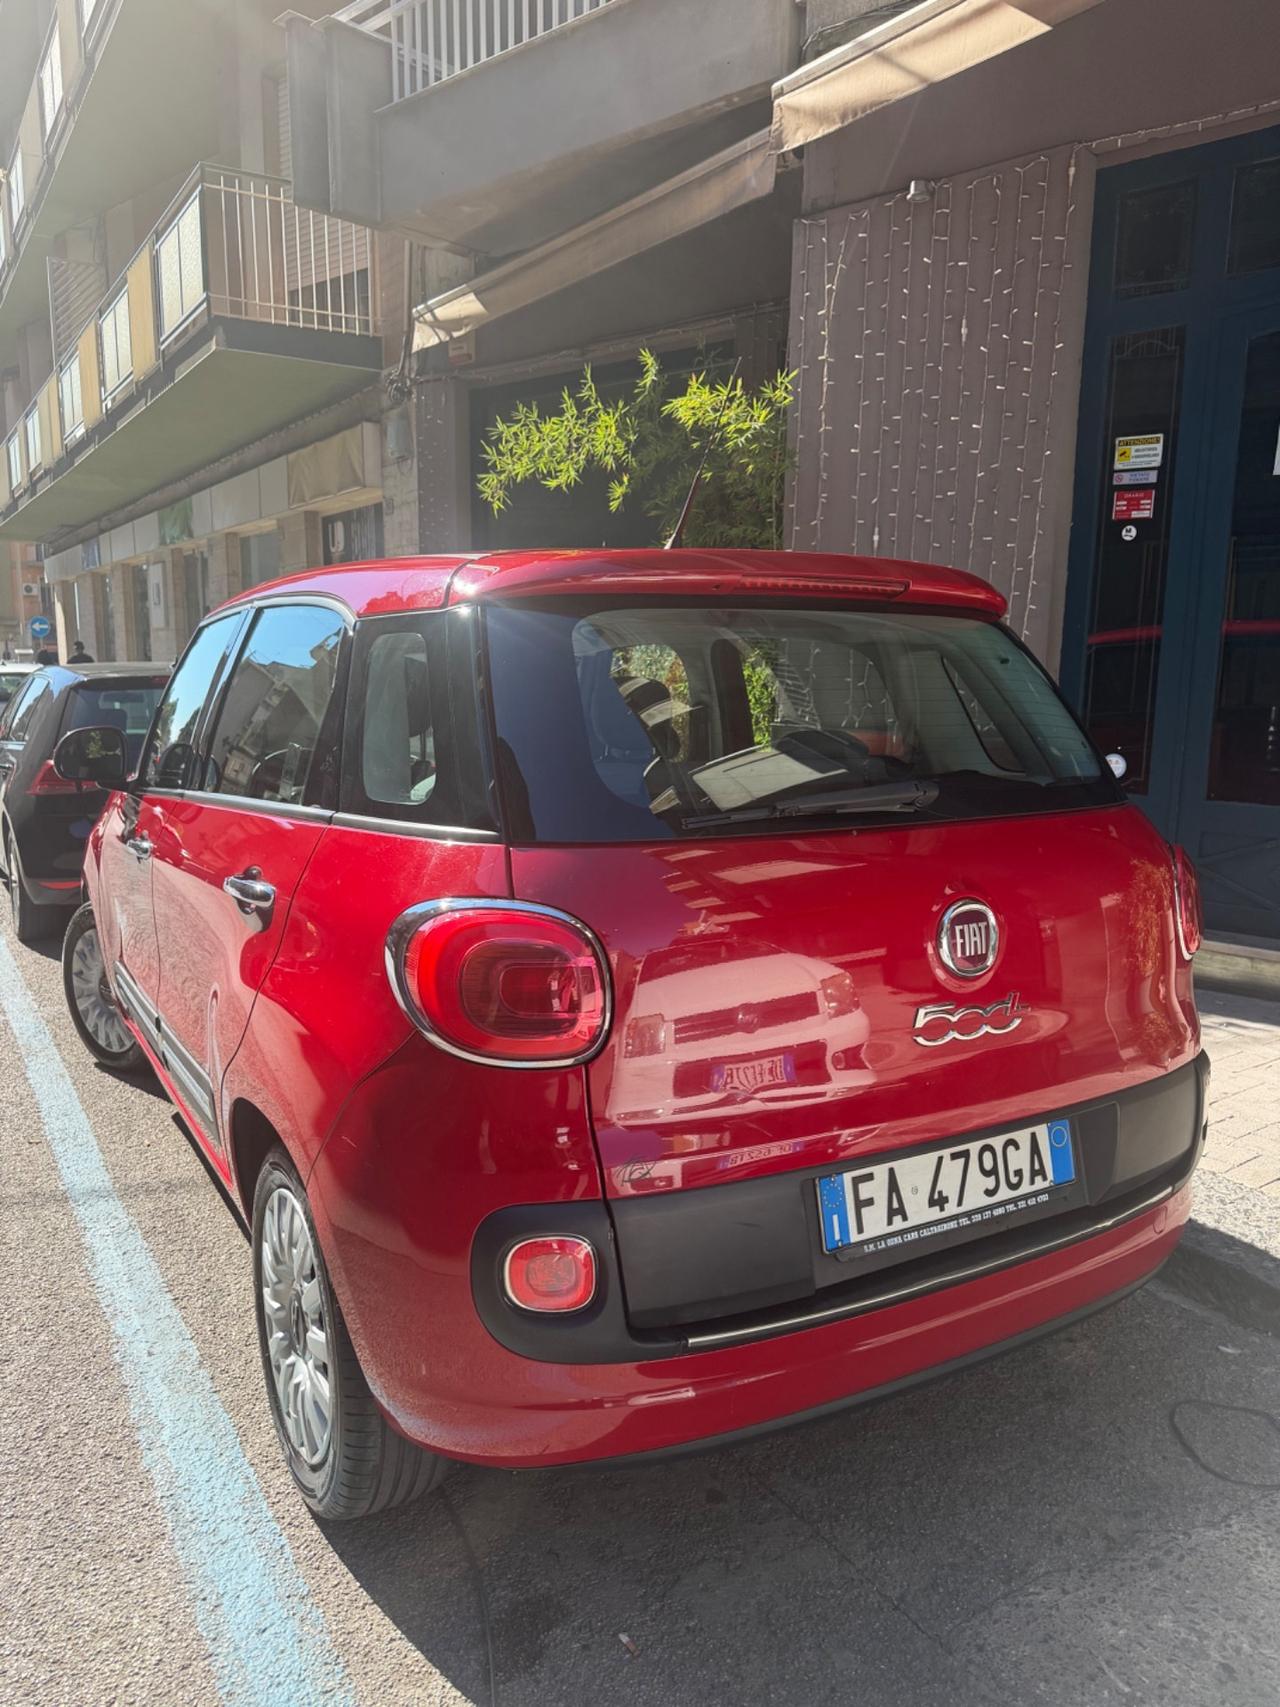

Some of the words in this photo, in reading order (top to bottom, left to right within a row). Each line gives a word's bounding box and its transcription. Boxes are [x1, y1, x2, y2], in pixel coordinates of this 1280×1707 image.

[955, 921, 988, 958] FIAT
[851, 1166, 908, 1235] FA
[928, 1131, 1049, 1212] 479GA
